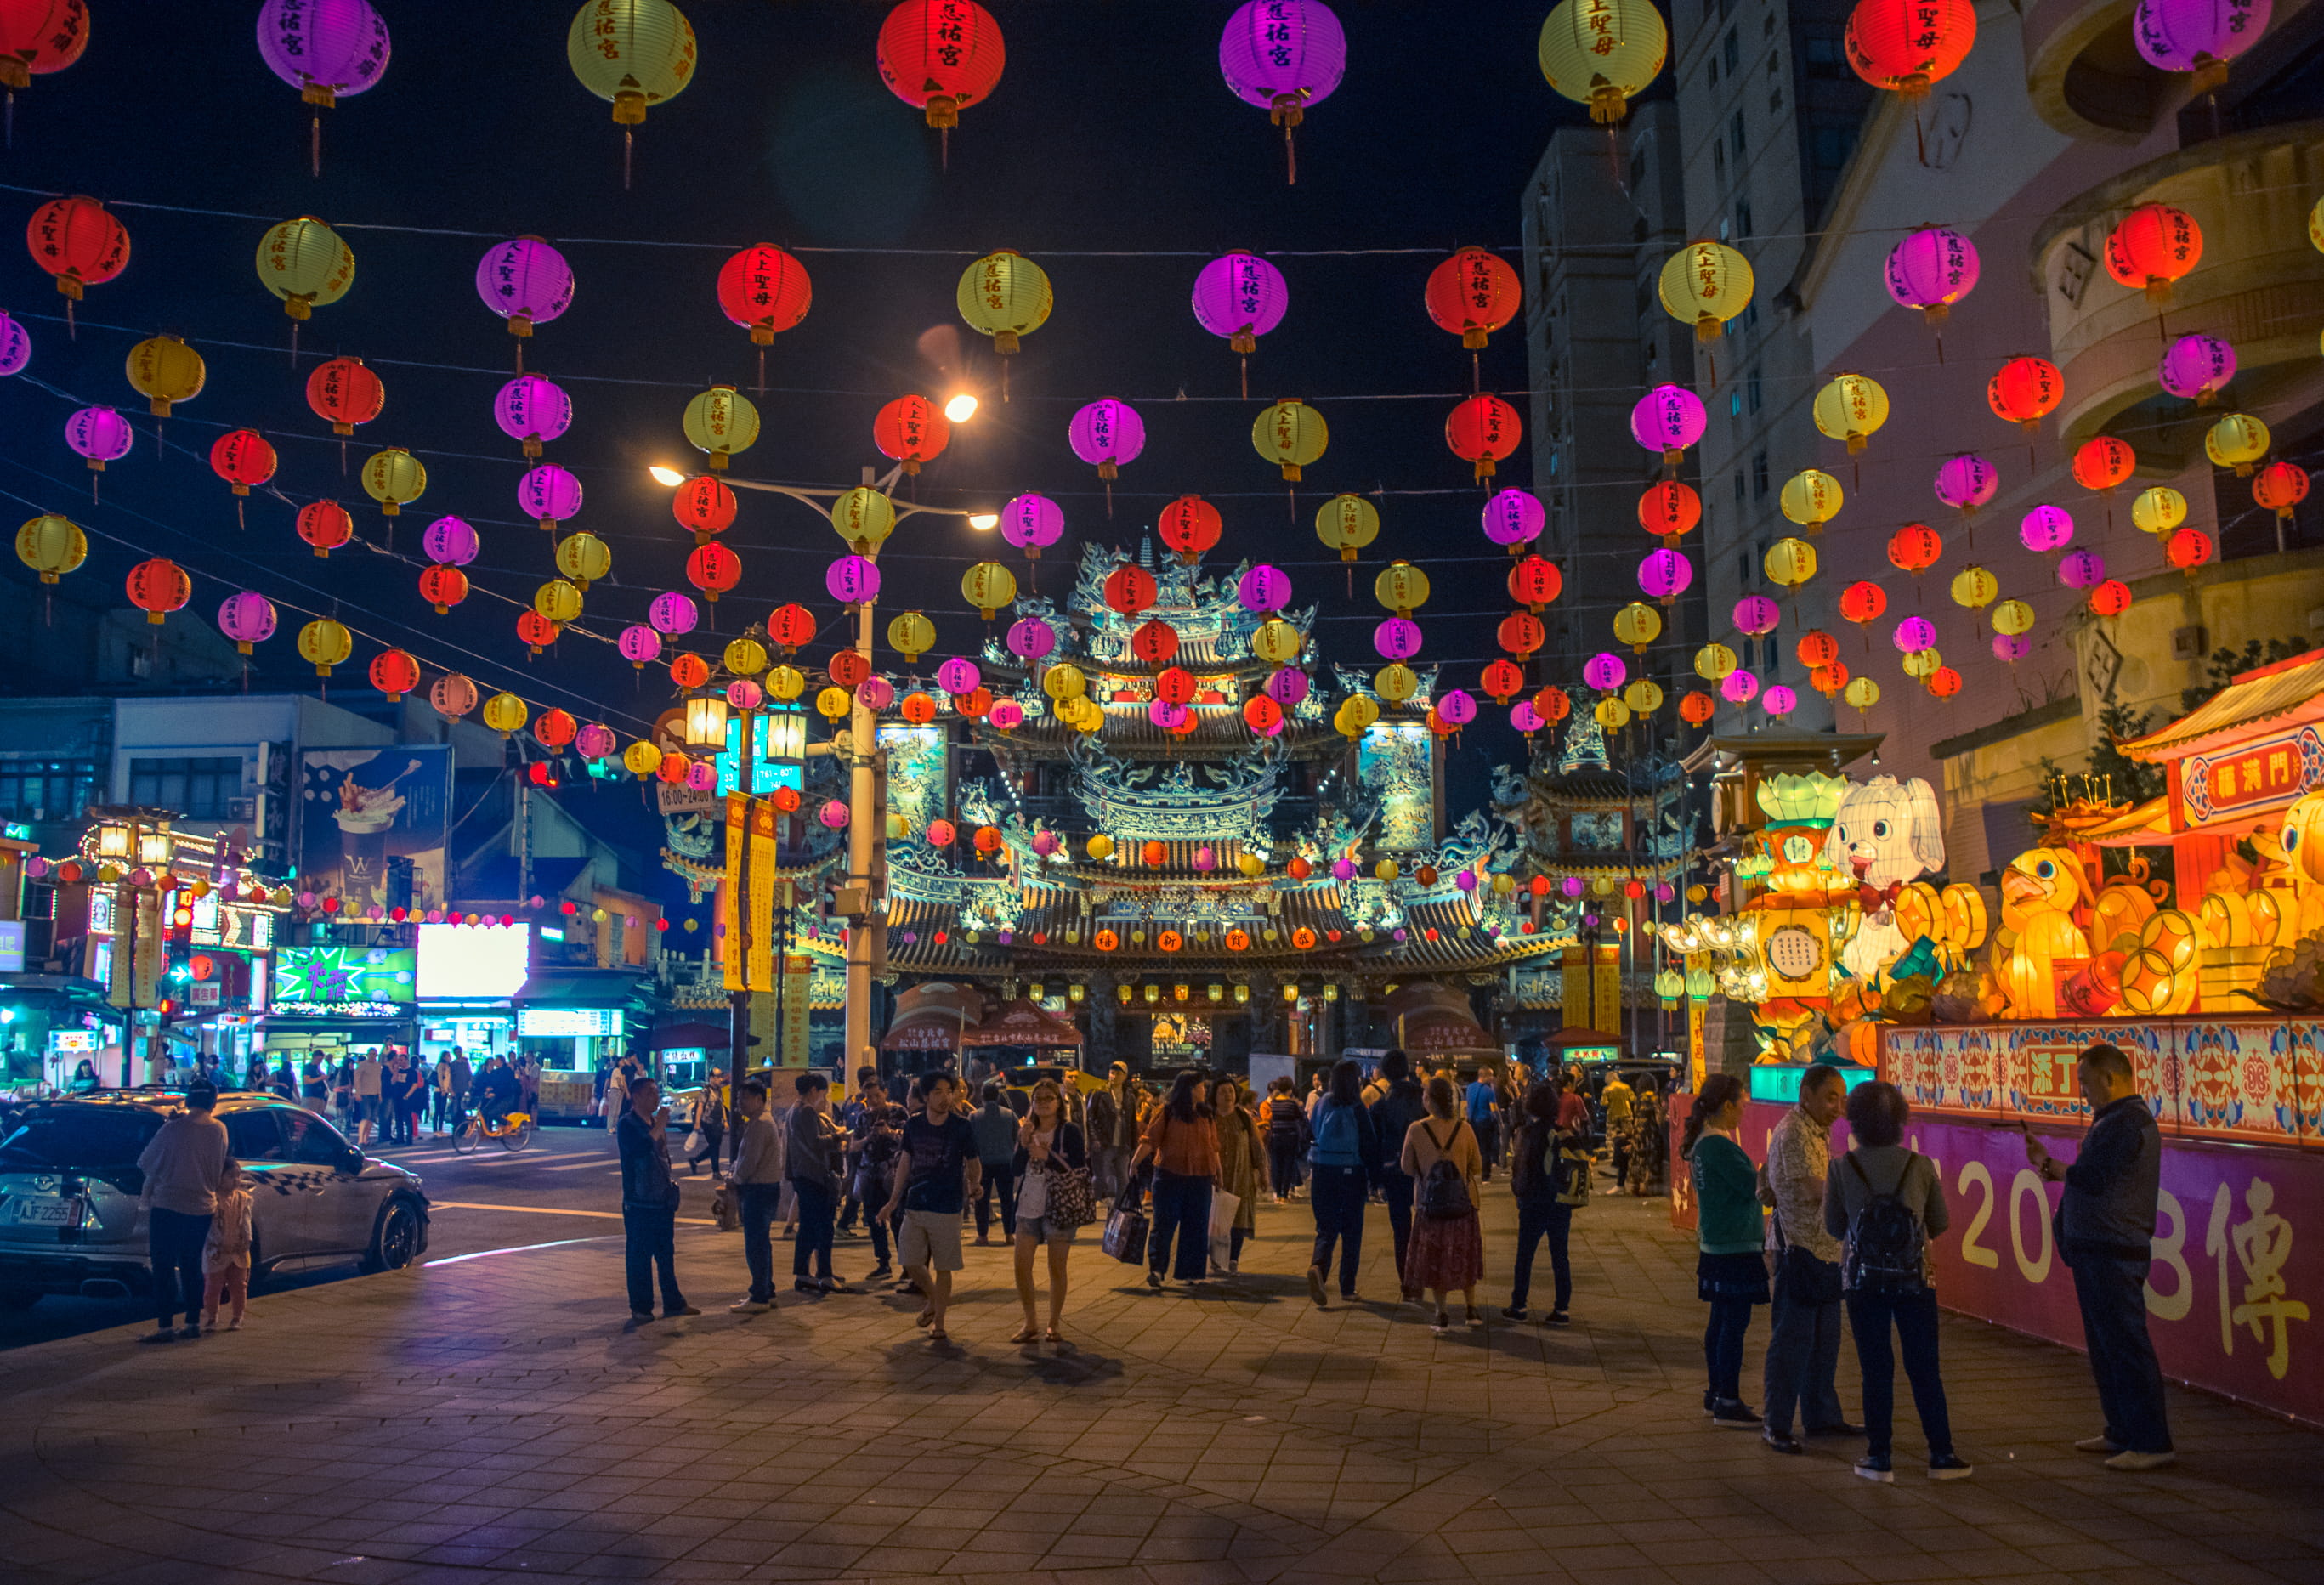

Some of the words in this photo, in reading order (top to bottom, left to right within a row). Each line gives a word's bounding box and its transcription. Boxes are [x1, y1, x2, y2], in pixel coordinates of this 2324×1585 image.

[938, 3, 966, 68] 慈祐宮
[1266, 4, 1294, 67] 慈祐宮
[1913, 0, 1941, 49] 聖母
[43, 201, 65, 258] 天上聖母
[2172, 214, 2191, 260] 慈祐宮
[499, 241, 523, 298] 天上聖母
[752, 248, 774, 306] 天上聖母
[1697, 246, 1720, 299] 天上聖母
[1947, 238, 1965, 286] 慈祐宮
[983, 264, 1006, 309] 慈祐宮
[1240, 265, 1261, 314] 慈祐宮
[1471, 261, 1491, 309] 慈祐宮
[711, 399, 728, 435] 慈祐宮
[906, 399, 924, 447] 天上聖母
[1487, 400, 1502, 444] 天上聖母
[1666, 399, 1683, 437] 慈祐宮
[1851, 385, 1868, 421] 慈祐宮
[1095, 410, 1111, 449] 慈祐宮
[1277, 405, 1294, 450] 天上聖母
[848, 492, 863, 530] 天上聖母
[1023, 498, 1036, 539] 天上聖母
[1180, 500, 1193, 541] 天上聖母
[1344, 502, 1358, 535] 慈祐宮
[2218, 751, 2290, 798] 福滿門
[1099, 934, 1111, 948] 禧
[1163, 934, 1176, 948] 新
[1230, 934, 1242, 947] 賀
[1299, 932, 1310, 945] 恭
[899, 1038, 950, 1049] 松山慈祐宮
[2032, 1055, 2075, 1096] 添丁
